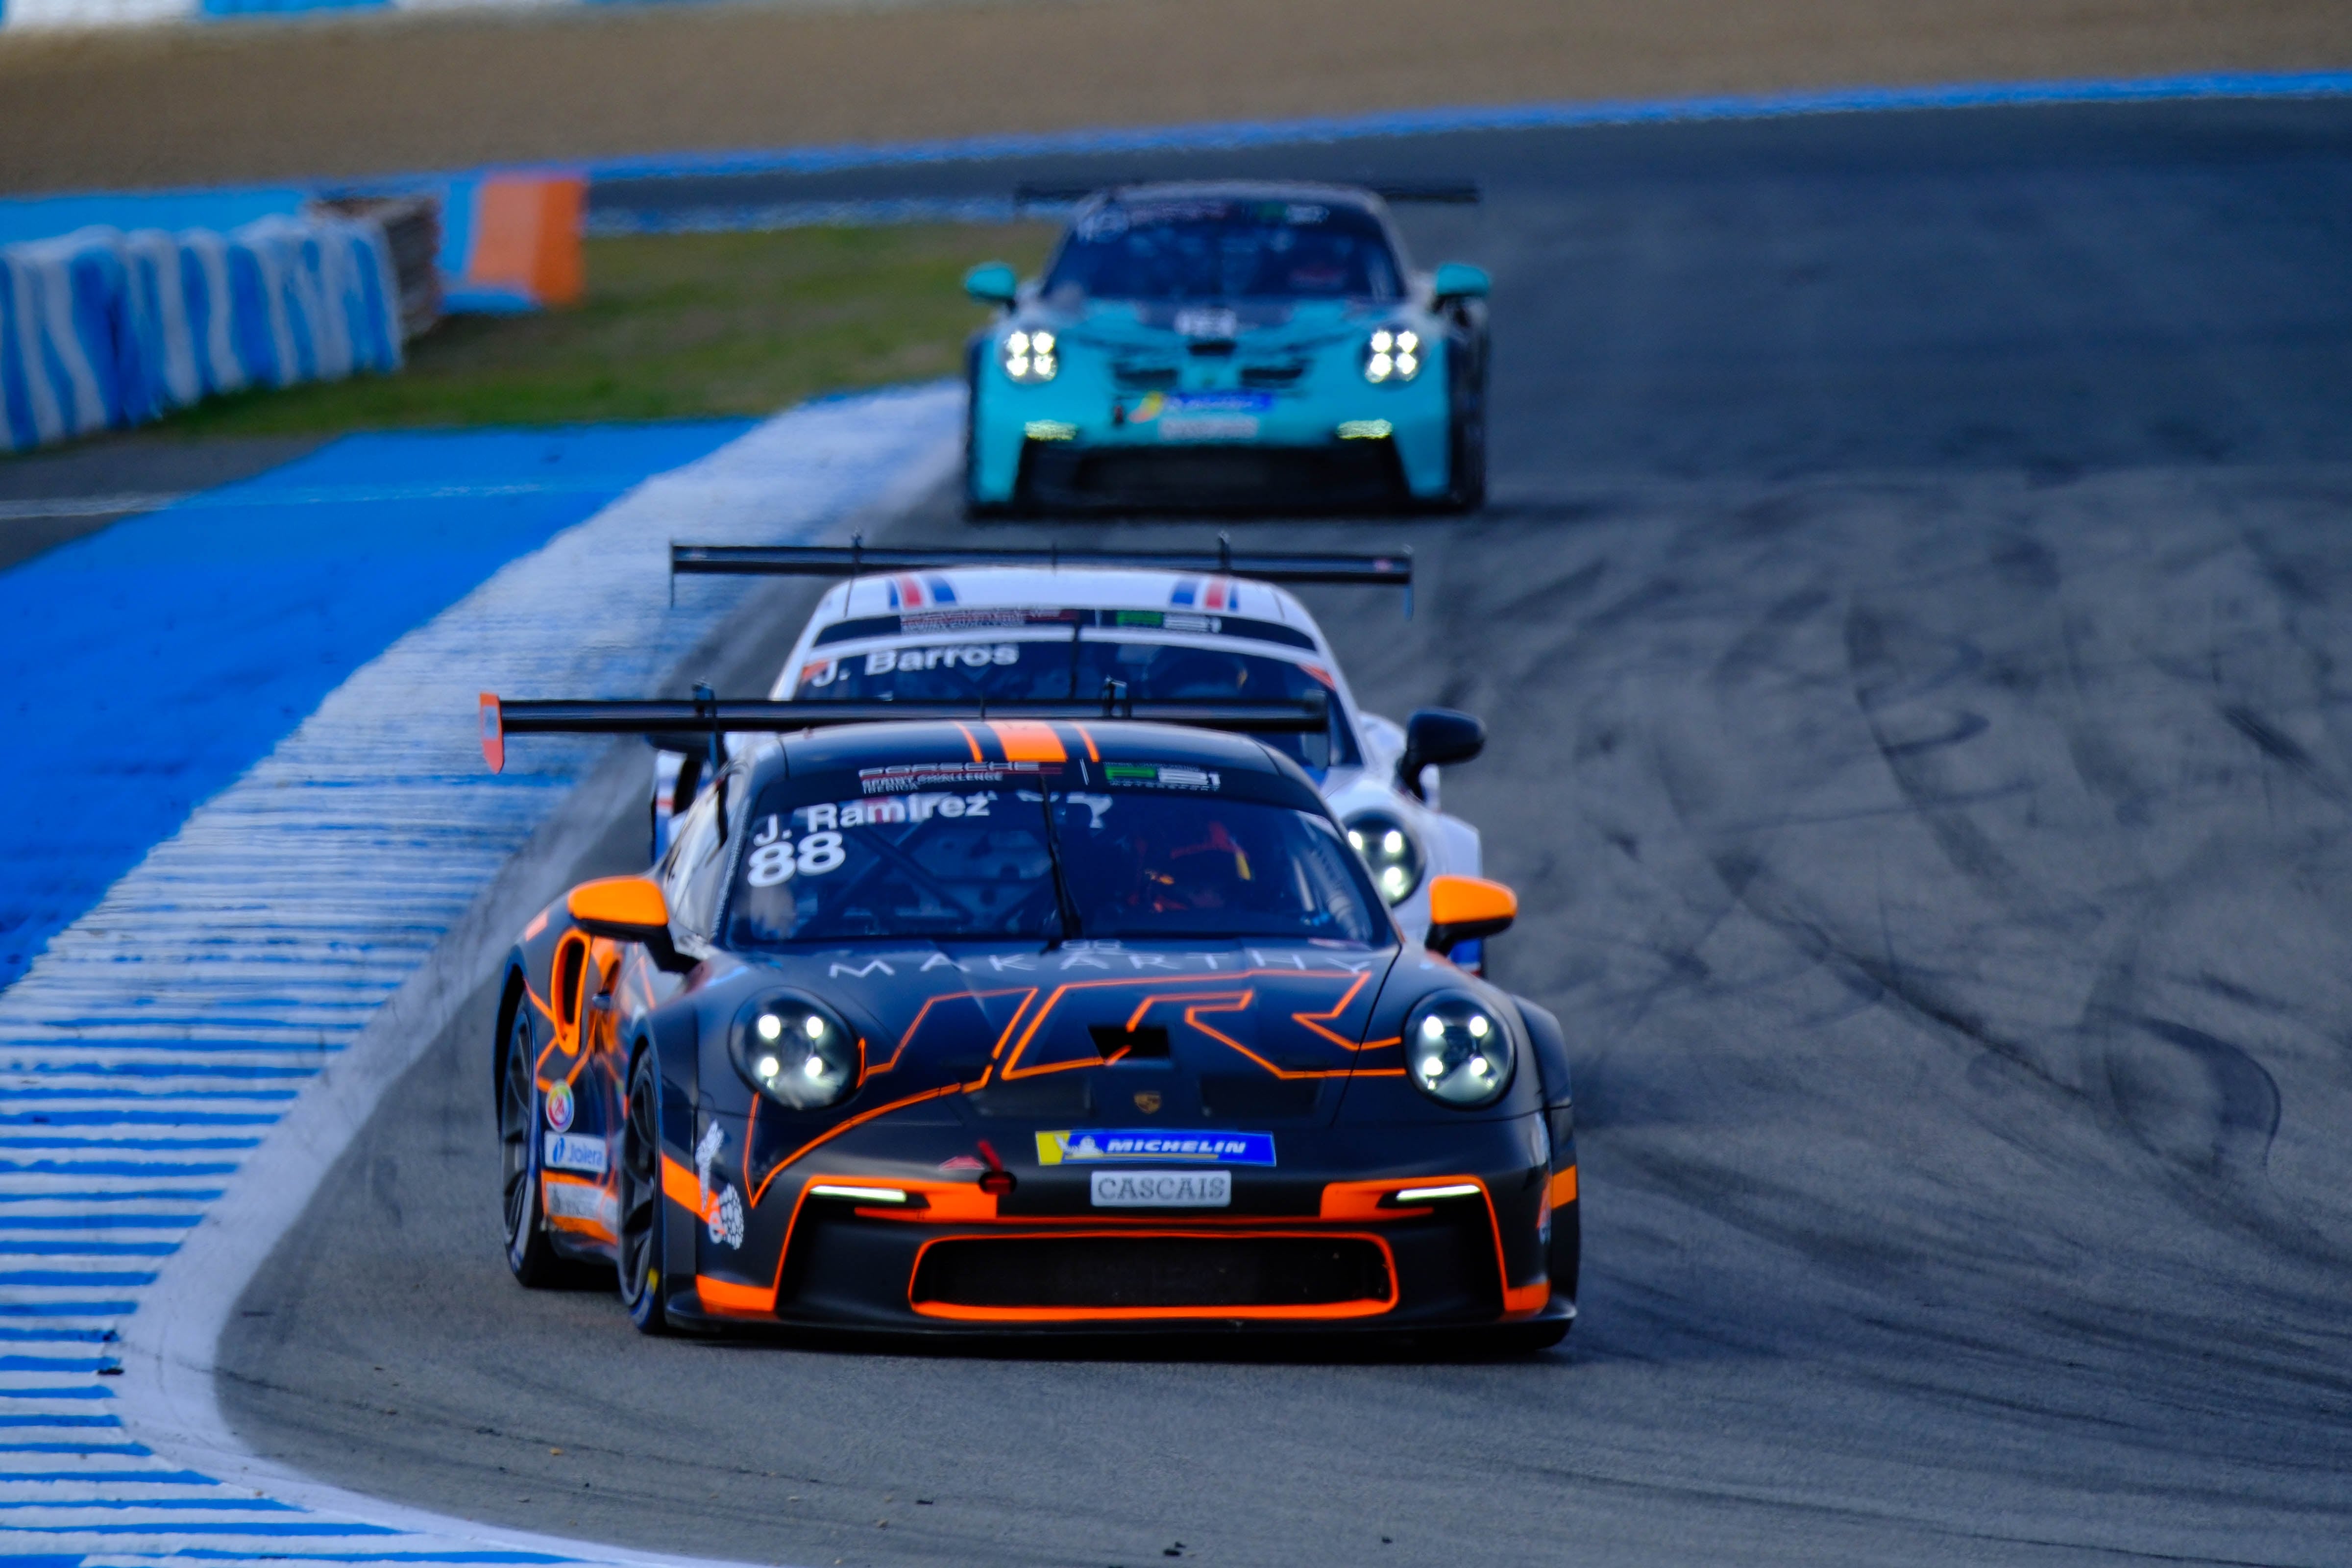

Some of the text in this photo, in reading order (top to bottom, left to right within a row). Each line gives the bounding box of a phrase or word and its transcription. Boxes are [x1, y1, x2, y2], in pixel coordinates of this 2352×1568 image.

[811, 644, 1020, 687] J. Barros
[753, 791, 991, 847] J. Ramirez
[747, 831, 846, 887] 88
[1106, 1139, 1246, 1153] MICHELIN
[1097, 1176, 1225, 1200] CASCAIS
